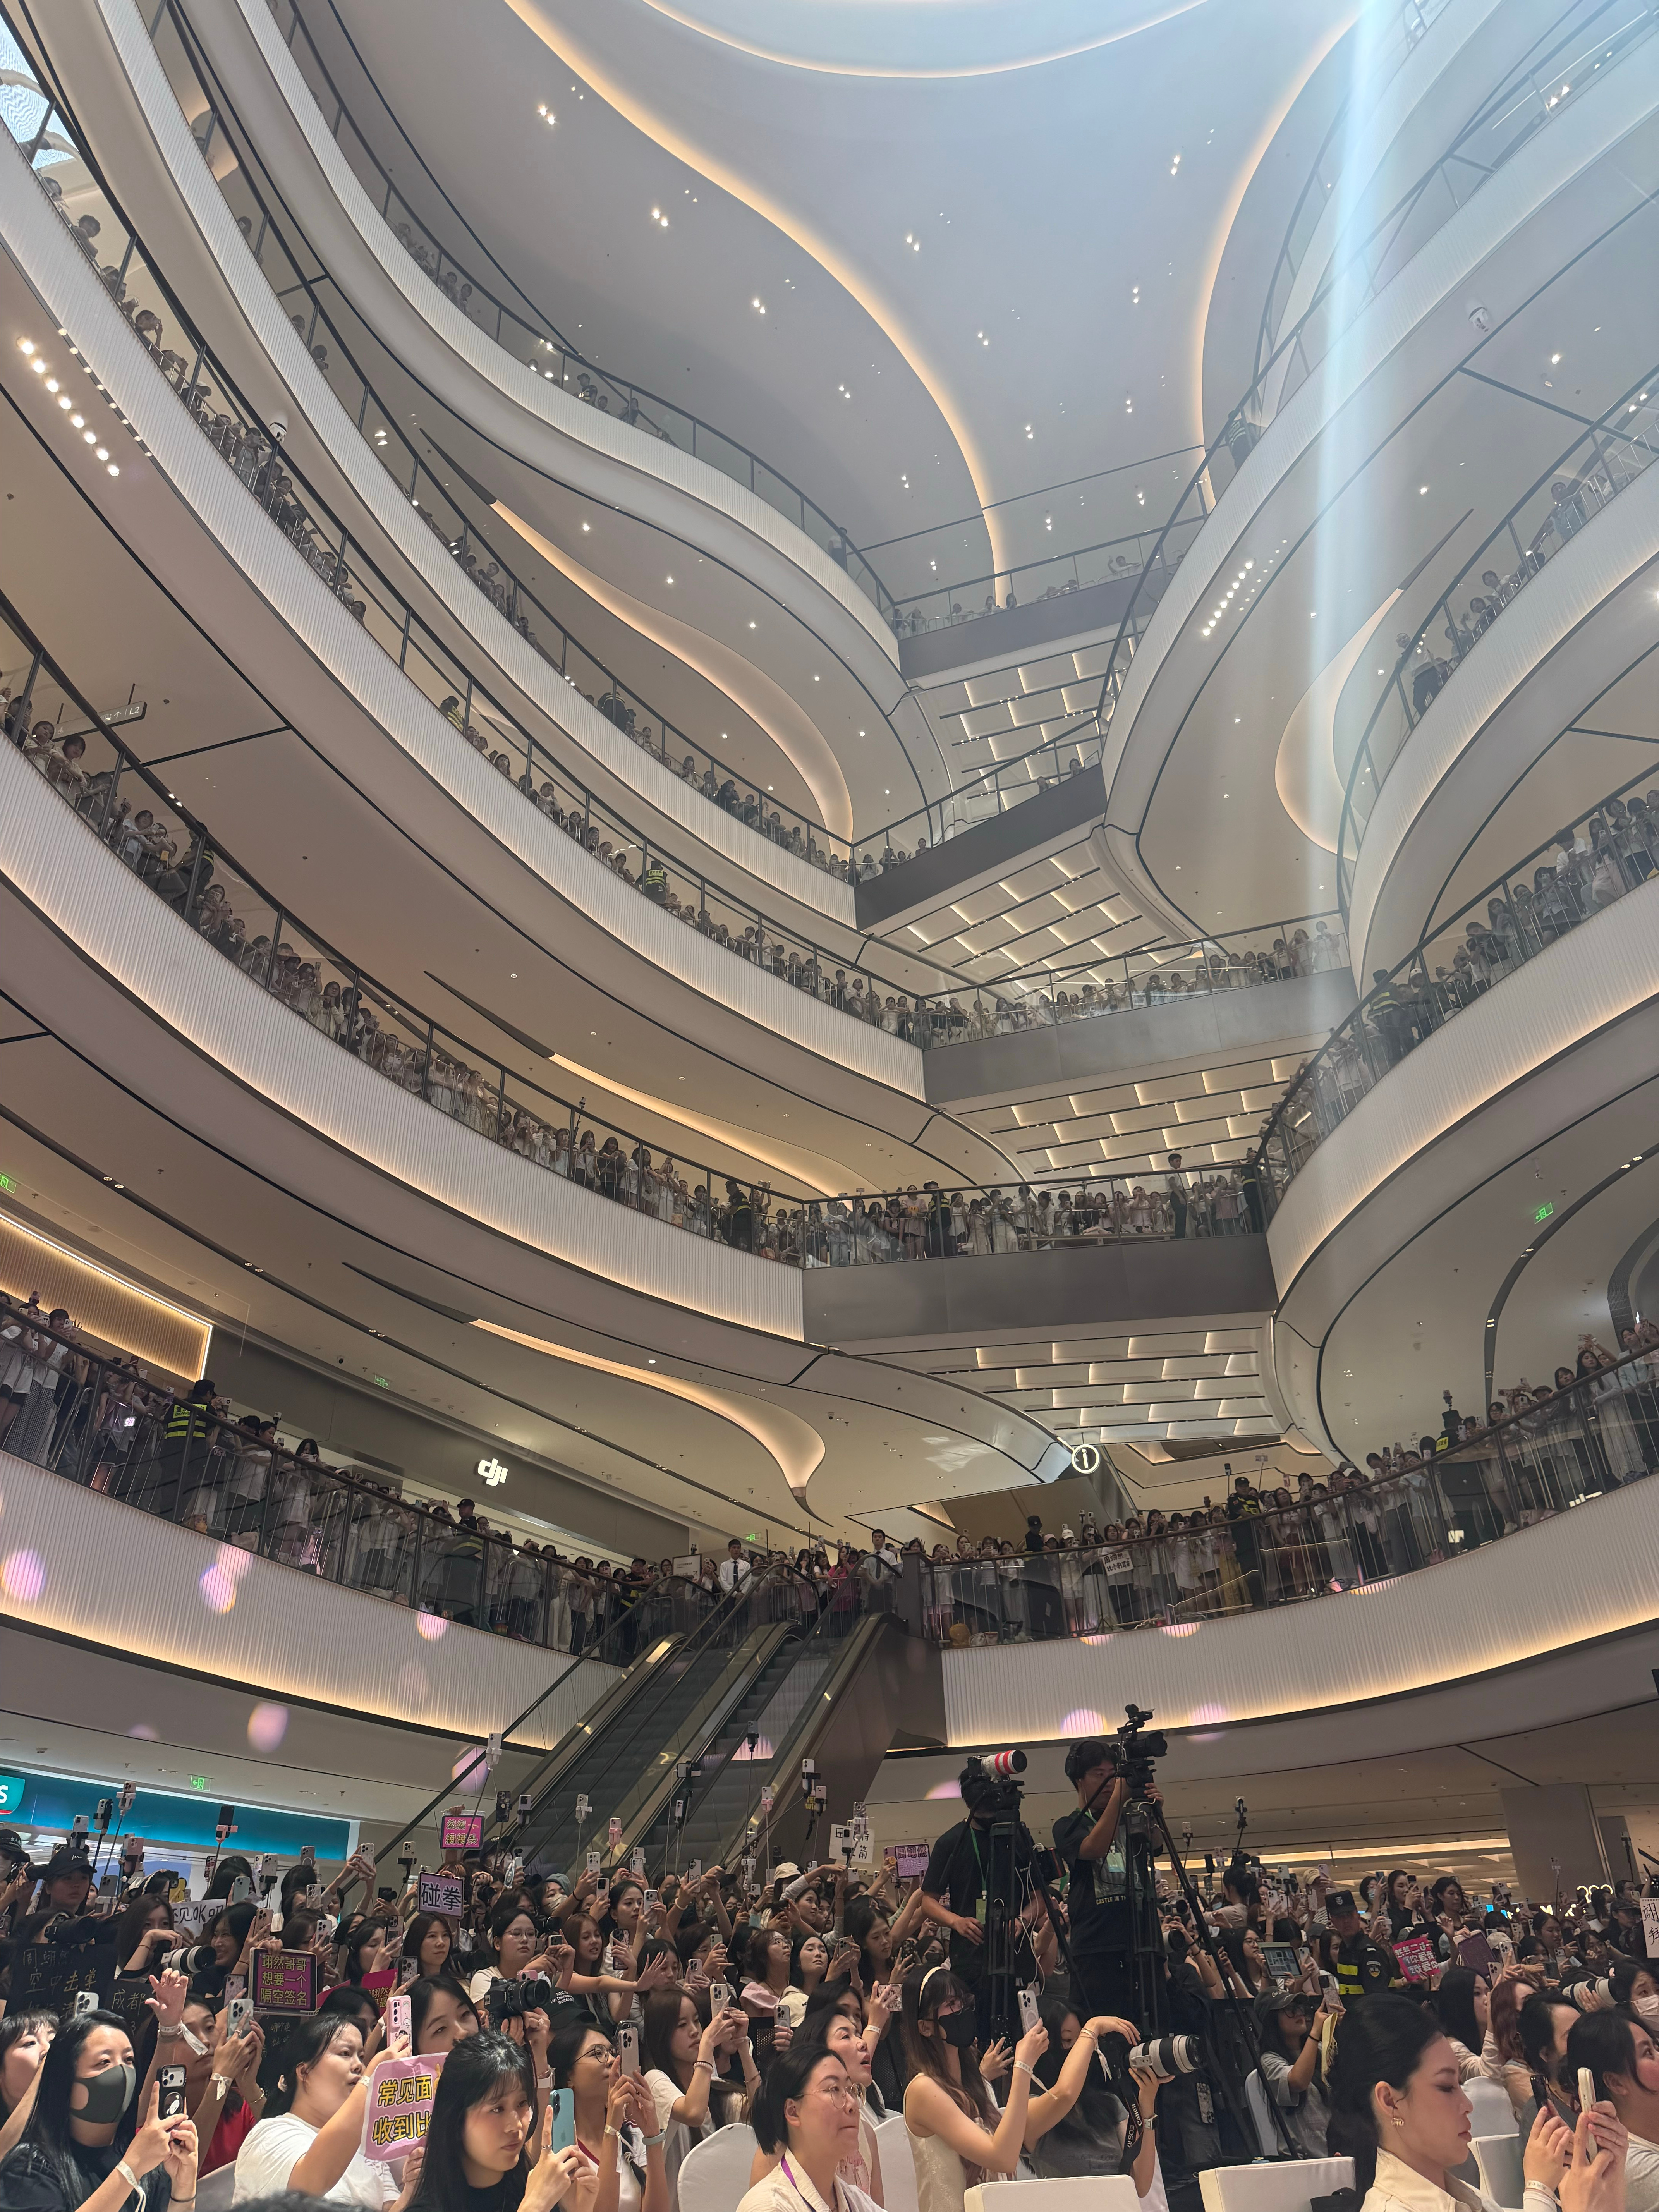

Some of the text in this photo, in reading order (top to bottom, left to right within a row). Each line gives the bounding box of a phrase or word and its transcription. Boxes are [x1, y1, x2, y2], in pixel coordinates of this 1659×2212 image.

[129, 706, 140, 715] L2
[421, 1882, 462, 1910] 碰拳
[1096, 1897, 1113, 1905] CASTLE
[262, 1955, 307, 1972] 翊然哥哥
[262, 1971, 306, 1988] 想要一个
[260, 1988, 307, 2006] 隔空签名
[377, 2075, 432, 2107] 常见面
[1132, 2104, 1142, 2126] Canon
